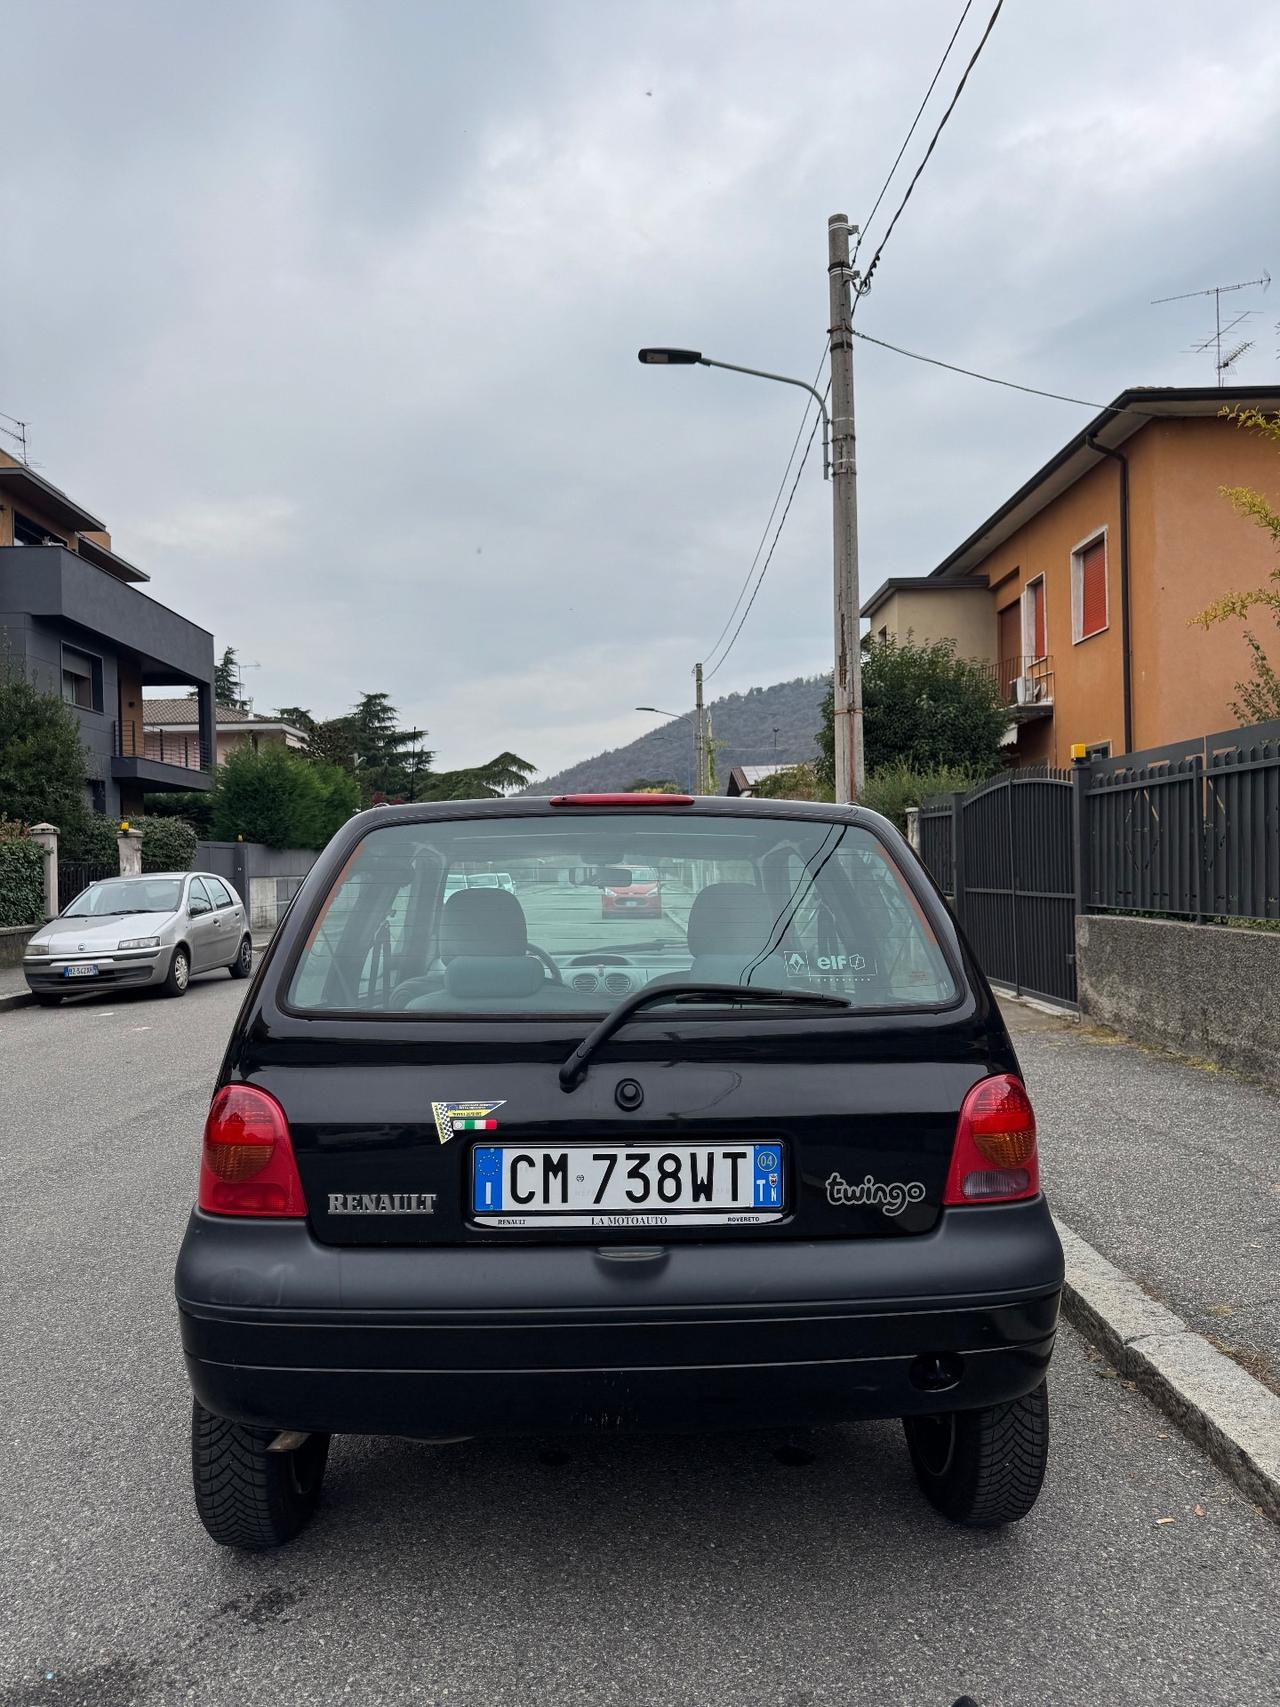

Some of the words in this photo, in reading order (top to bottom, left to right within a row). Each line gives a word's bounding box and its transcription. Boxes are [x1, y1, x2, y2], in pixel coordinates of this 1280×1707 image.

[817, 955, 847, 970] elf
[760, 1155, 773, 1167] 04
[510, 1153, 569, 1205] CM
[592, 1151, 748, 1204] 738WT
[825, 1172, 926, 1216] twingo
[327, 1193, 437, 1215] RENAULT
[497, 1218, 526, 1226] RENAULT
[591, 1216, 605, 1226] LA
[607, 1215, 668, 1226] MOTOAUTO
